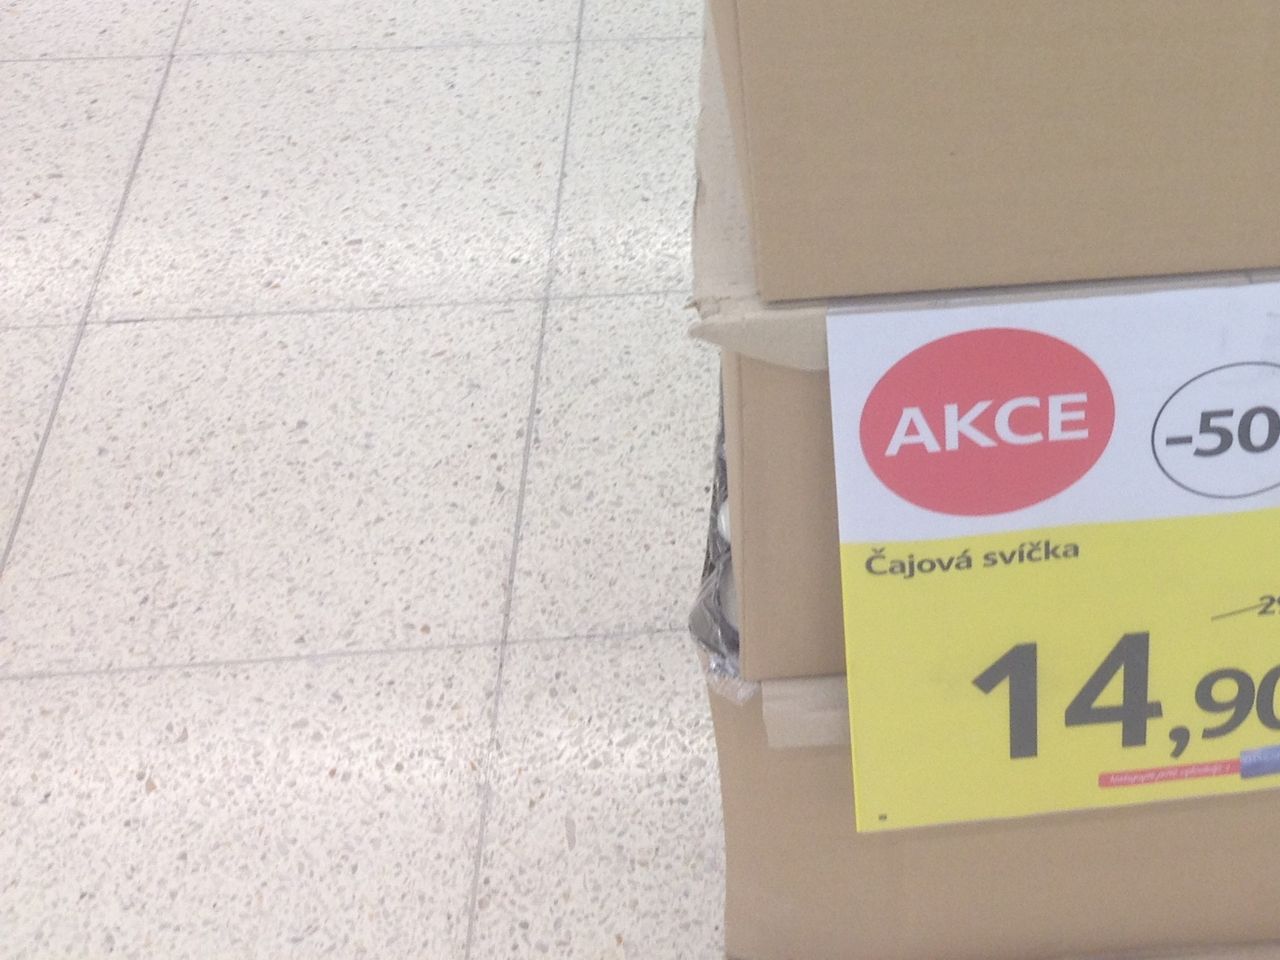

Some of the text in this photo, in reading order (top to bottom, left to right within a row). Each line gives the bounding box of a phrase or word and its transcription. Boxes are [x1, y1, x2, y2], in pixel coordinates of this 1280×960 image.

[884, 392, 1089, 456] AKCE
[864, 539, 1080, 579] Čajová svíčka
